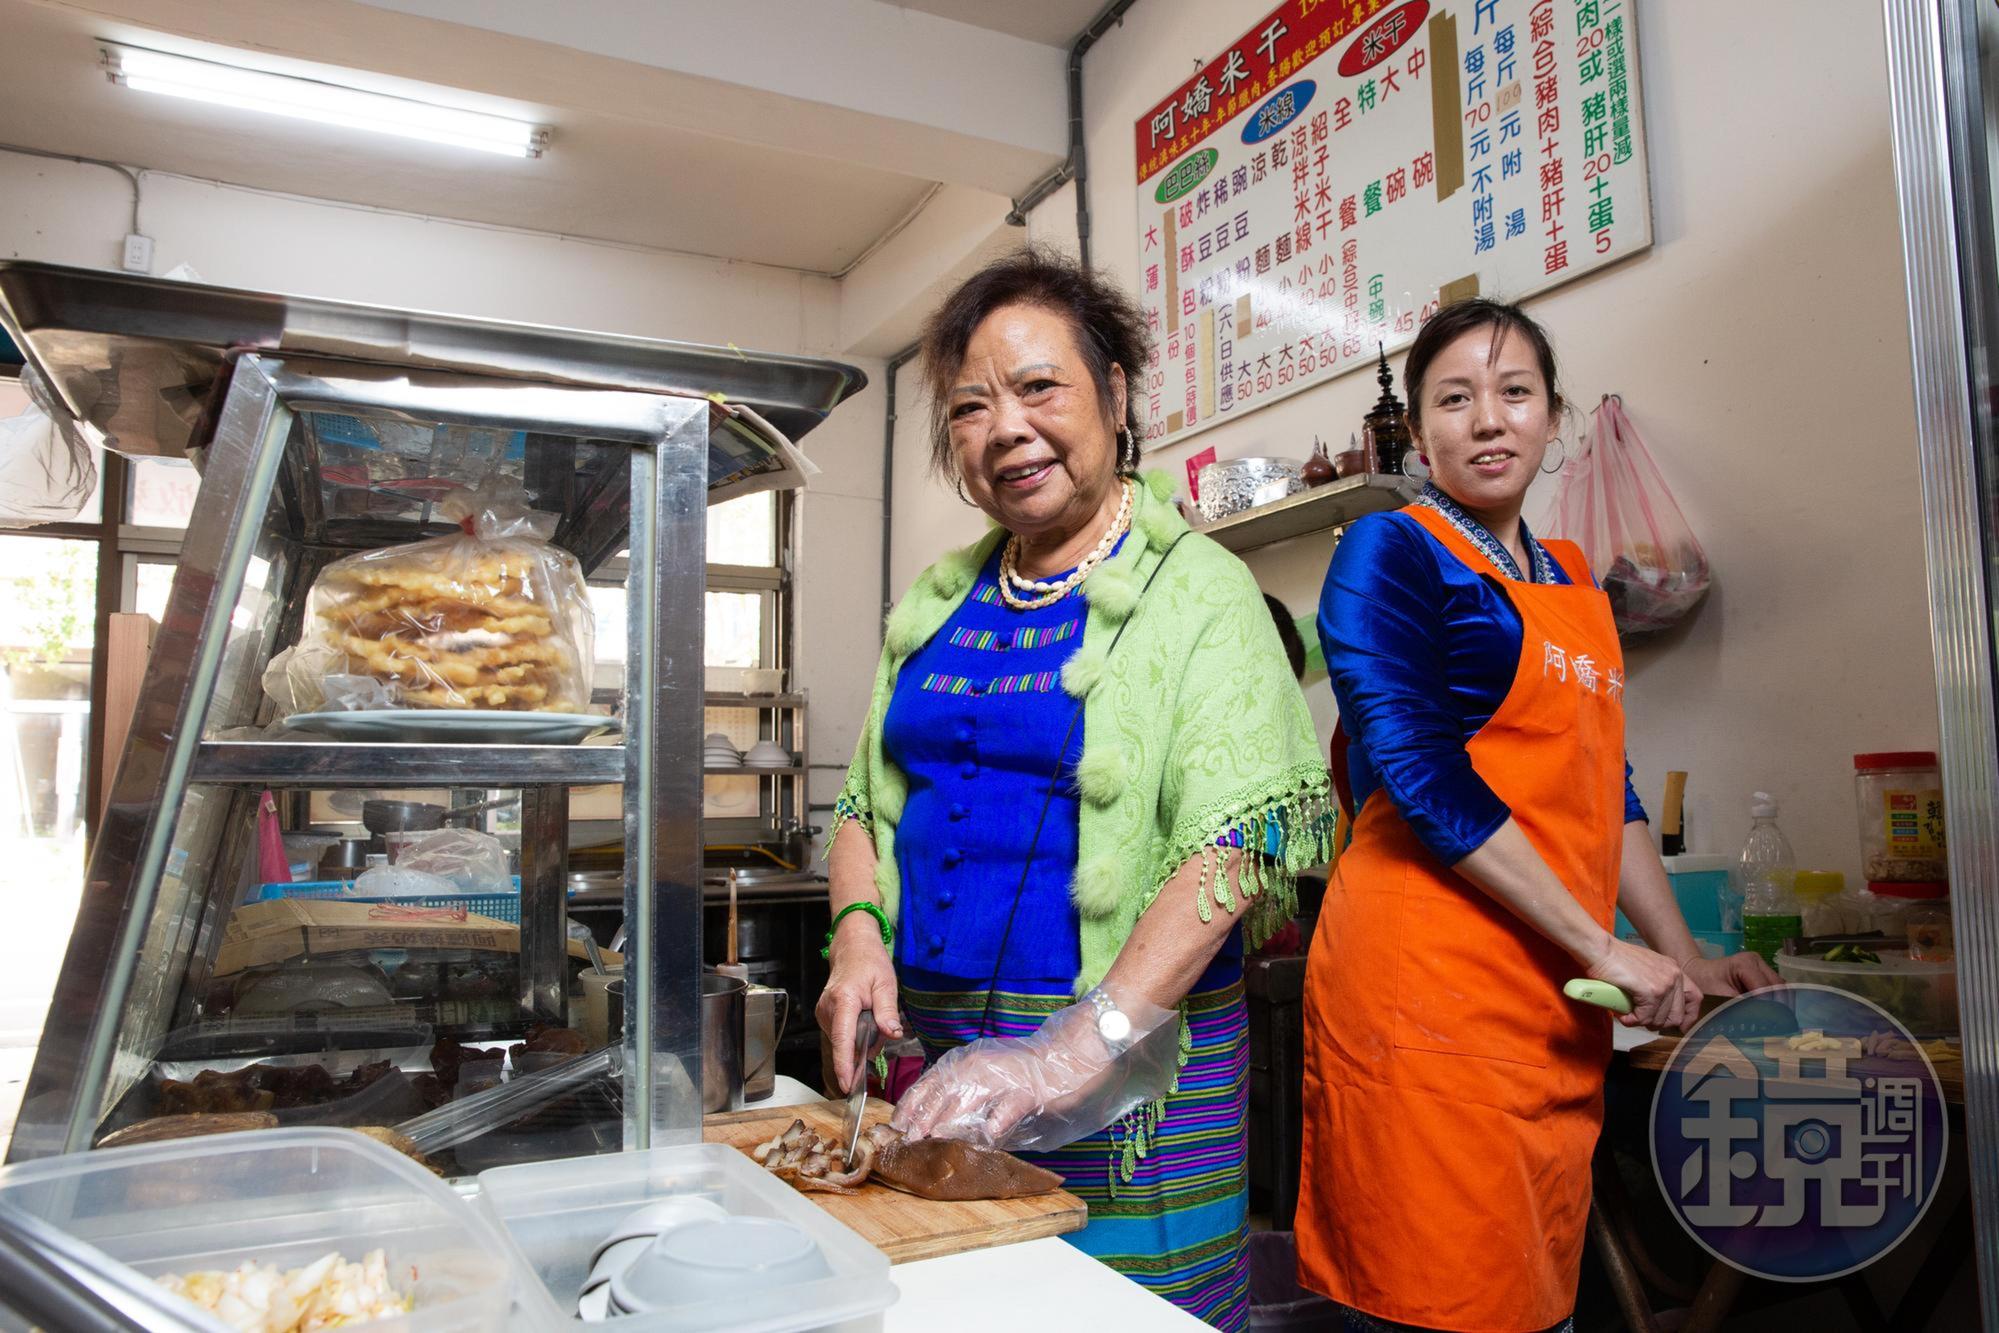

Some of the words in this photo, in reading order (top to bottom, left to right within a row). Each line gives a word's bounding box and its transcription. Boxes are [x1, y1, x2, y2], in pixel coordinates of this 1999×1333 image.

[1152, 19, 1287, 148] 阿嬌米干
[1362, 11, 1406, 65] 米干
[1603, 0, 1632, 165] 一樣或選兩樣量減)
[1165, 150, 1210, 199] 巴巴絲
[1258, 91, 1296, 137] 米線
[1311, 110, 1332, 240] 紹子米干
[1291, 125, 1312, 254] 涼拌米線
